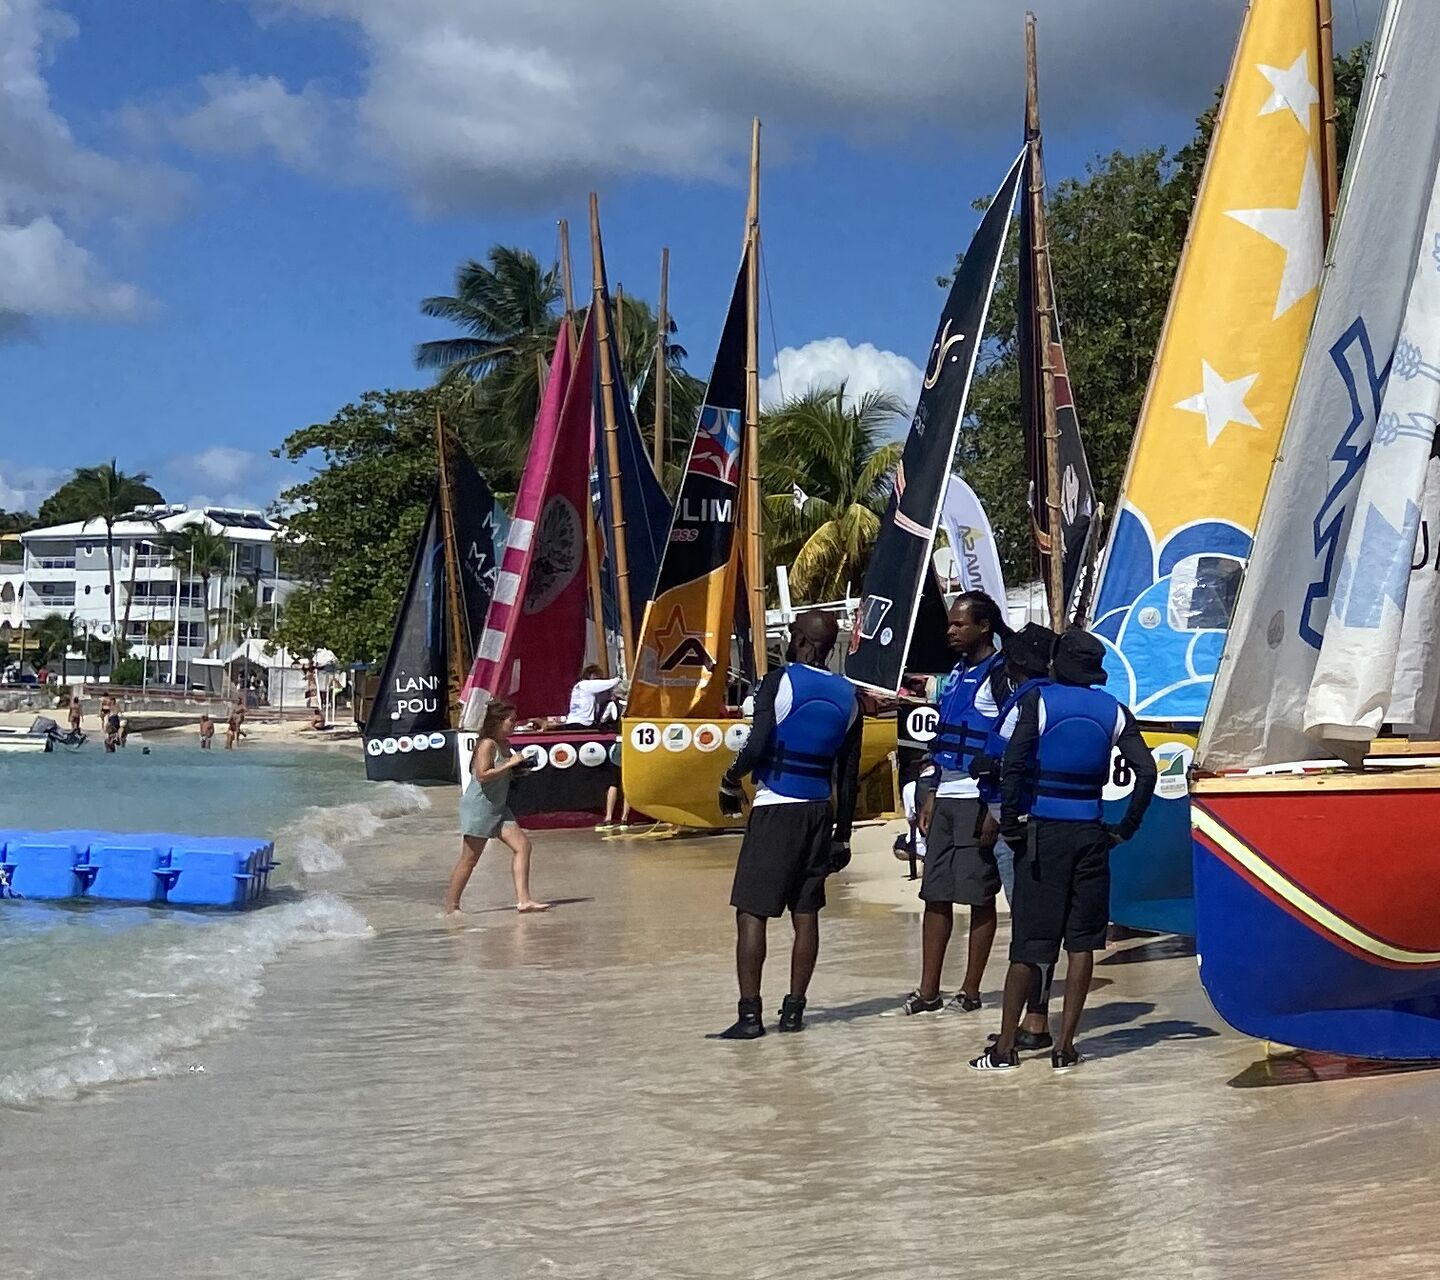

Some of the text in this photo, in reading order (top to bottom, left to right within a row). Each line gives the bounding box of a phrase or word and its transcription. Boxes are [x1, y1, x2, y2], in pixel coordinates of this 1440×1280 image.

[676, 497, 732, 523] LIM
[912, 713, 937, 733] 06
[466, 737, 477, 752] 0
[636, 728, 655, 745] 13
